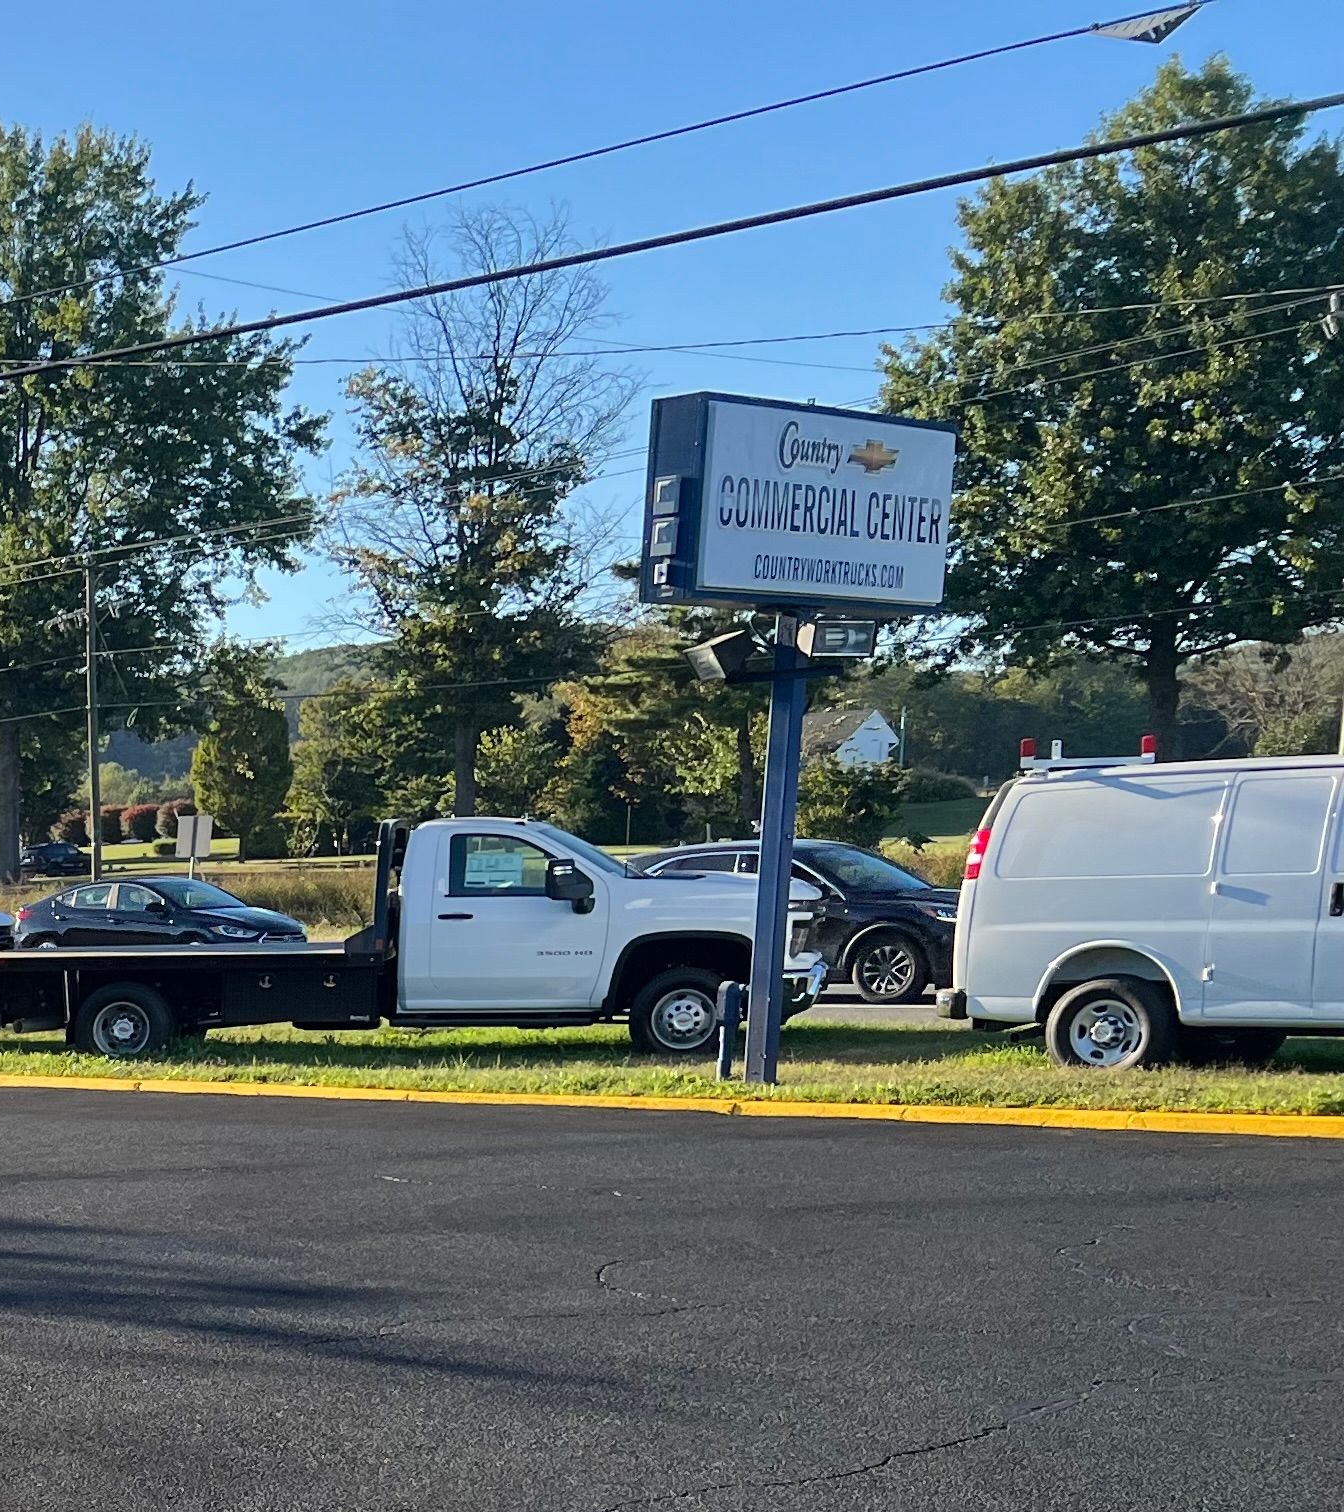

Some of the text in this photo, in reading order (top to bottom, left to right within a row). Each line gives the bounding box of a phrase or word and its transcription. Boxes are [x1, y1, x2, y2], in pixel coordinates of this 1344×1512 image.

[779, 420, 844, 474] Country
[719, 474, 943, 545] COMMERCIAL CENTER
[754, 553, 905, 589] COUNTRYWORKTRUCKS.COM
